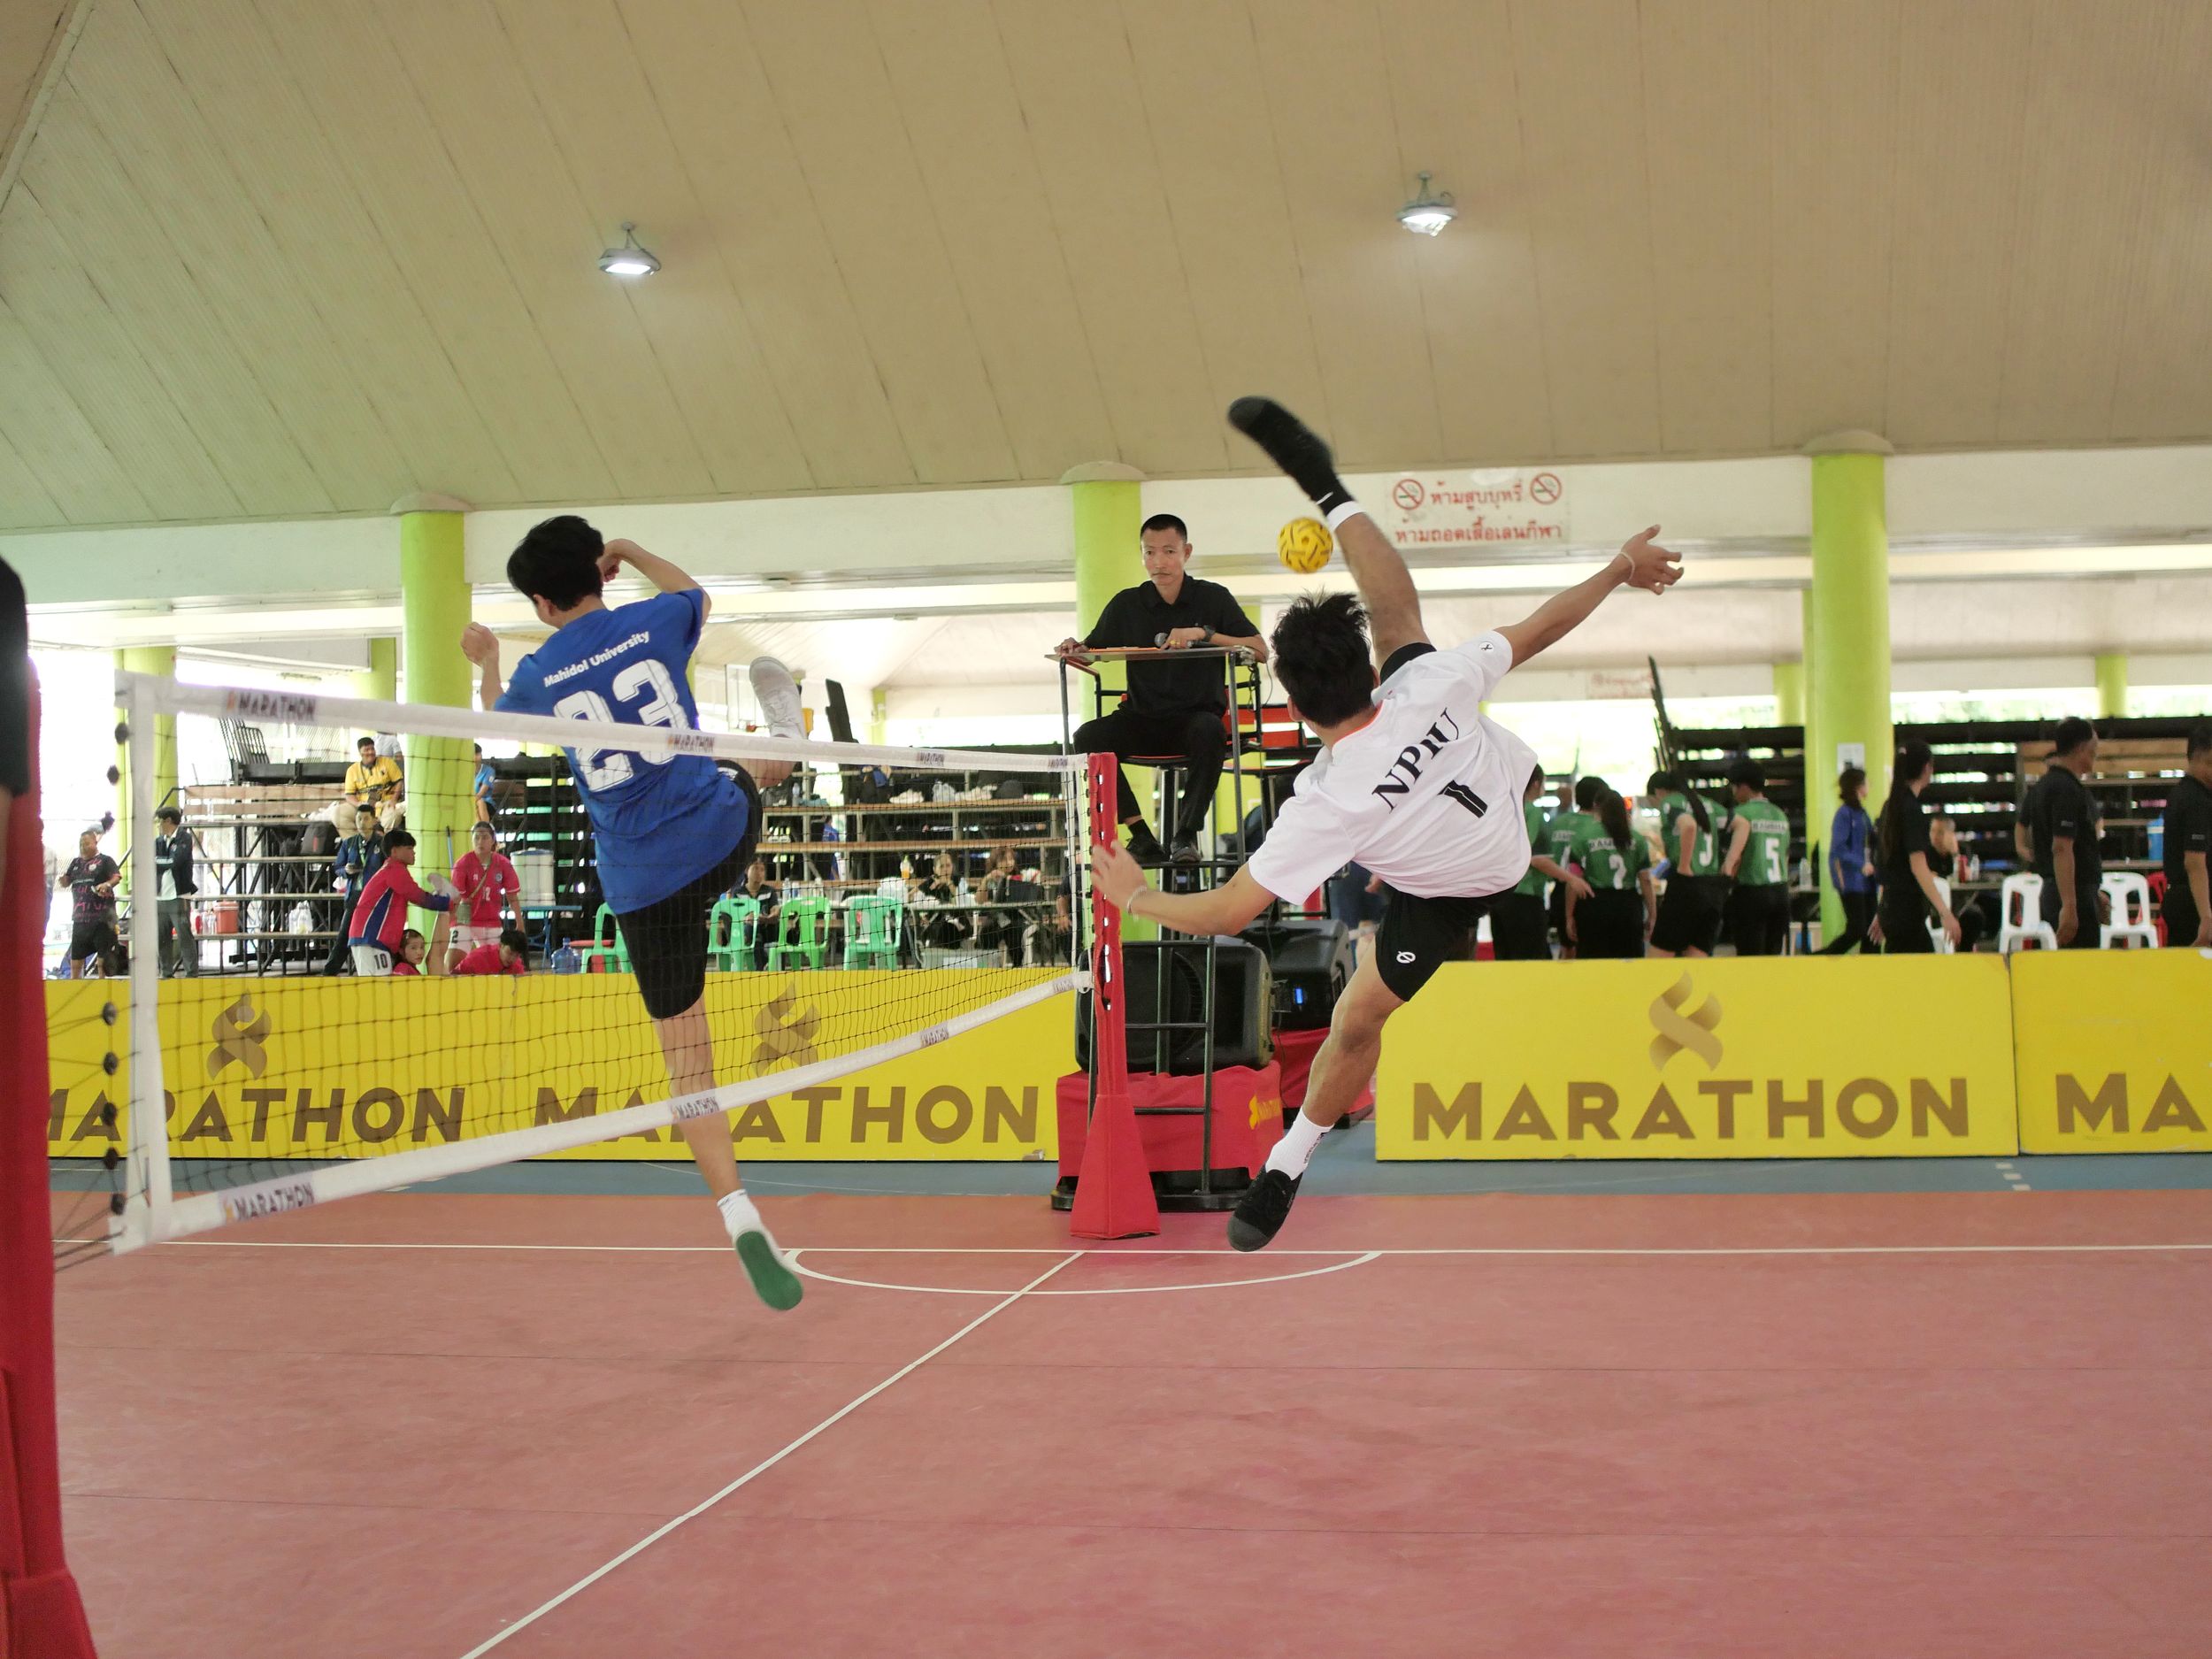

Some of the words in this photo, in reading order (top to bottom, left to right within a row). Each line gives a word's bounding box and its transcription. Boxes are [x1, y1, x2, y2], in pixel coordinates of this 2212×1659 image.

[542, 659, 589, 687] Mahidol
[589, 631, 650, 666] University
[238, 692, 317, 722] MARATHON
[553, 658, 692, 793] 23
[1437, 780, 1488, 818] 1
[1765, 837, 1782, 883] 5
[373, 953, 388, 970] 10
[48, 1087, 465, 1143] AATHON
[534, 1087, 1039, 1143] MAATHON
[1412, 1078, 1970, 1142] MARATHON
[2055, 1072, 2208, 1133] MA
[234, 1182, 315, 1220] MARATHON
